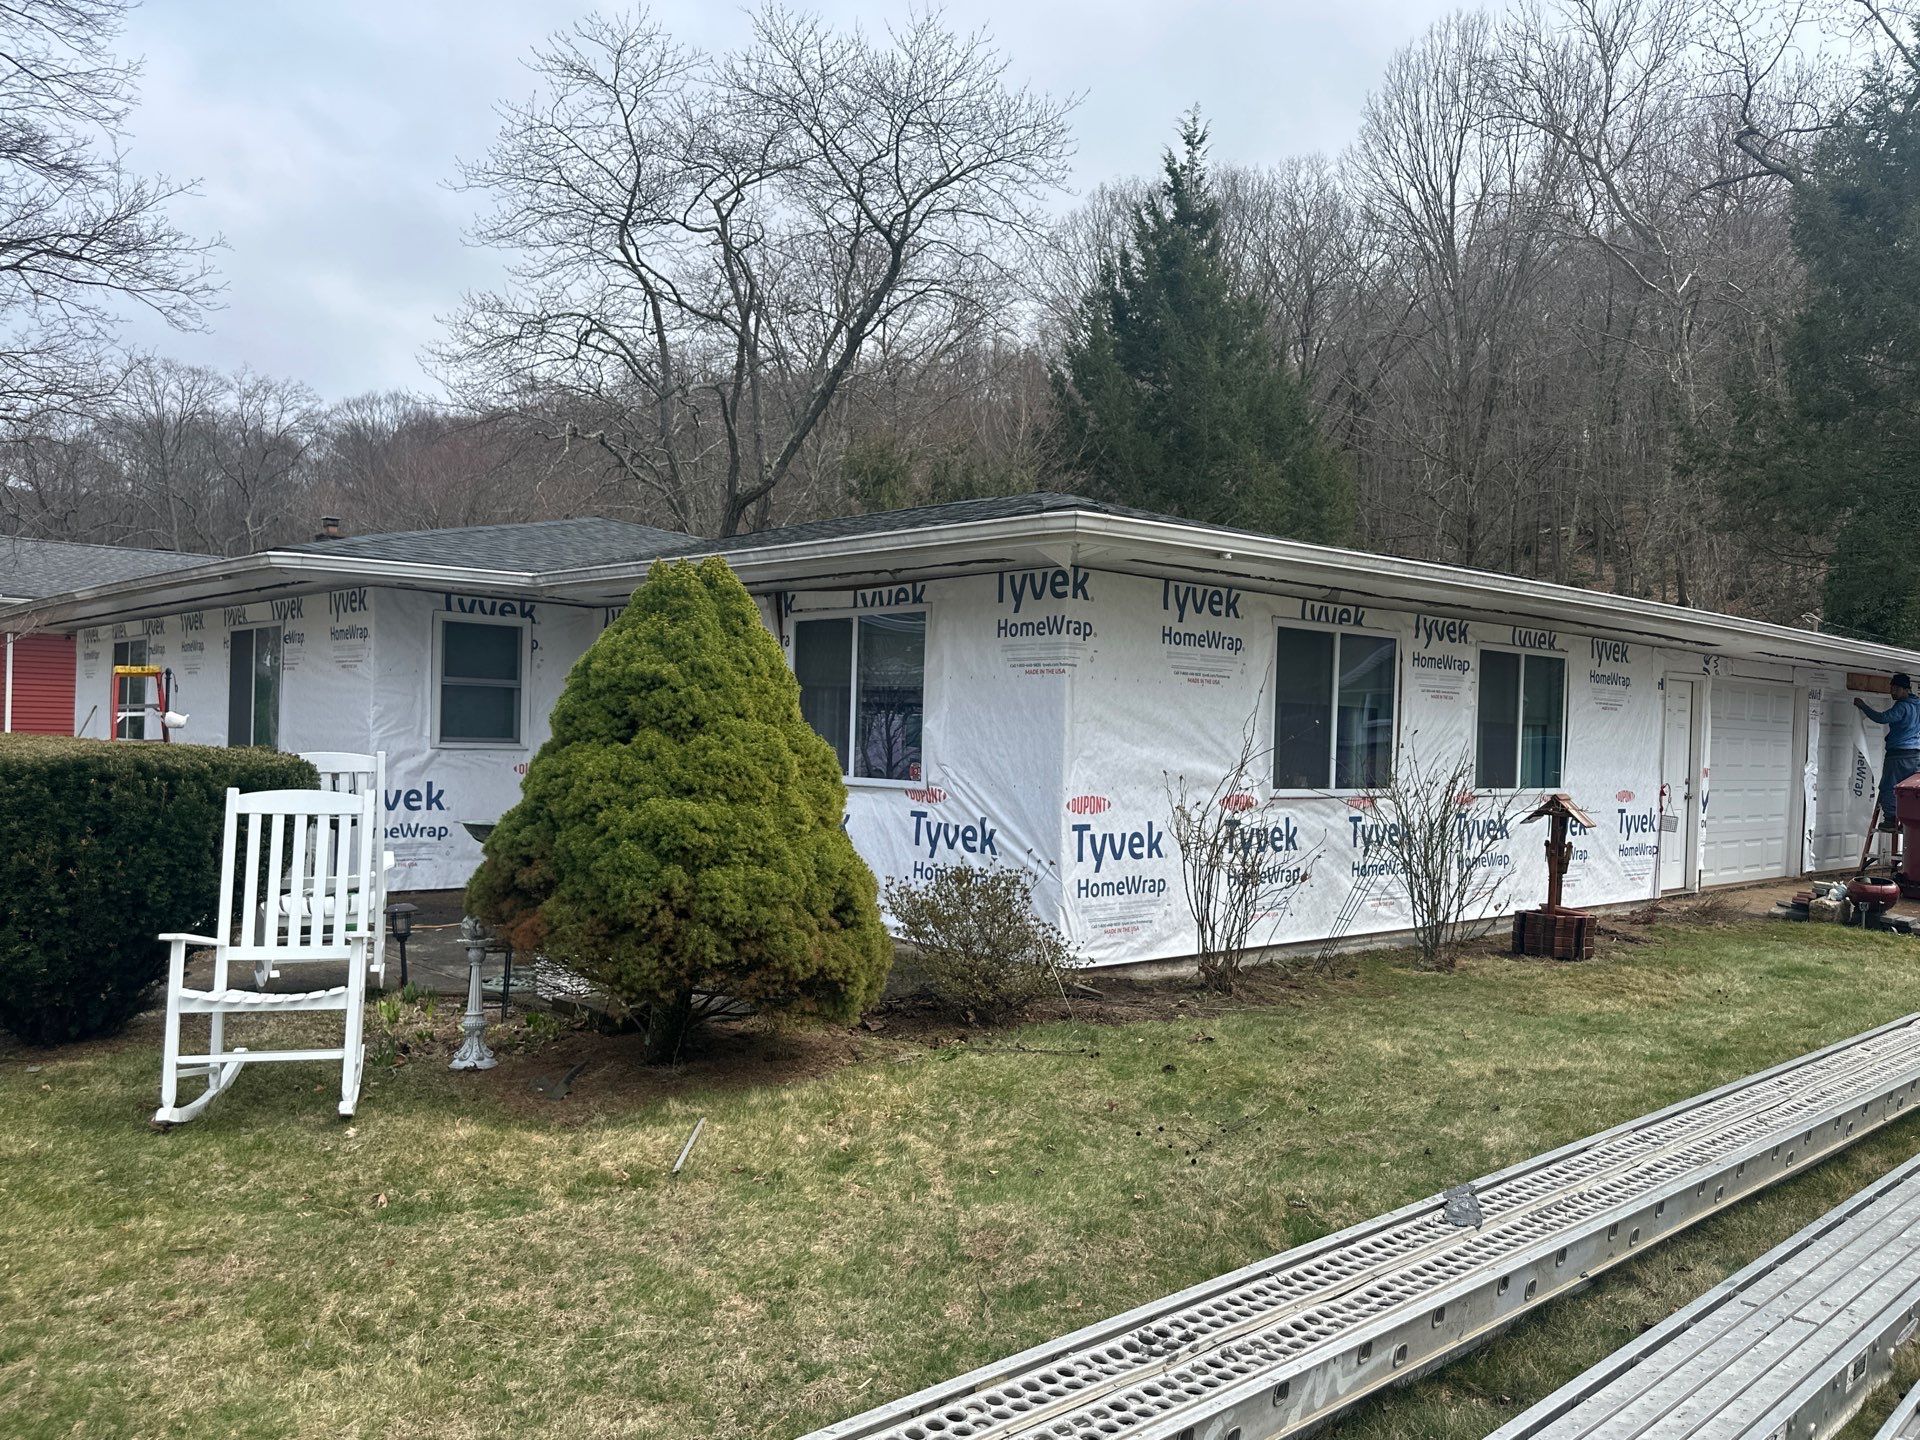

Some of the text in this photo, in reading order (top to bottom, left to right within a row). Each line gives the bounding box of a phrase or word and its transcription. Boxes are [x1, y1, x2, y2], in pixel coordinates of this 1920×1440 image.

[998, 566, 1090, 613] Tyvek
[1163, 580, 1241, 623] Tyvek
[329, 586, 368, 623] Tyvek
[284, 630, 304, 647] eWrap
[331, 624, 369, 642] HomeWrap
[997, 614, 1093, 641] HomeWrap
[1162, 626, 1243, 655] HomeWrap
[1414, 614, 1469, 649] Tyvek
[1412, 651, 1471, 675] HomeWrap
[1589, 636, 1629, 668] Tyvek
[1589, 669, 1631, 690] HomeWrap
[385, 781, 445, 811] vek
[1071, 795, 1107, 814] DUPONT
[373, 823, 449, 841] eWrap
[910, 810, 998, 859] Tyvek
[1456, 811, 1510, 850] Tyvek
[1618, 808, 1656, 841] Tyvek
[1072, 821, 1164, 874] Tyvek
[1225, 817, 1298, 864] Tyvek
[1619, 843, 1659, 859] HomeWrap
[1078, 875, 1167, 898] HomeWrap
[1228, 867, 1301, 887] HeWrap
